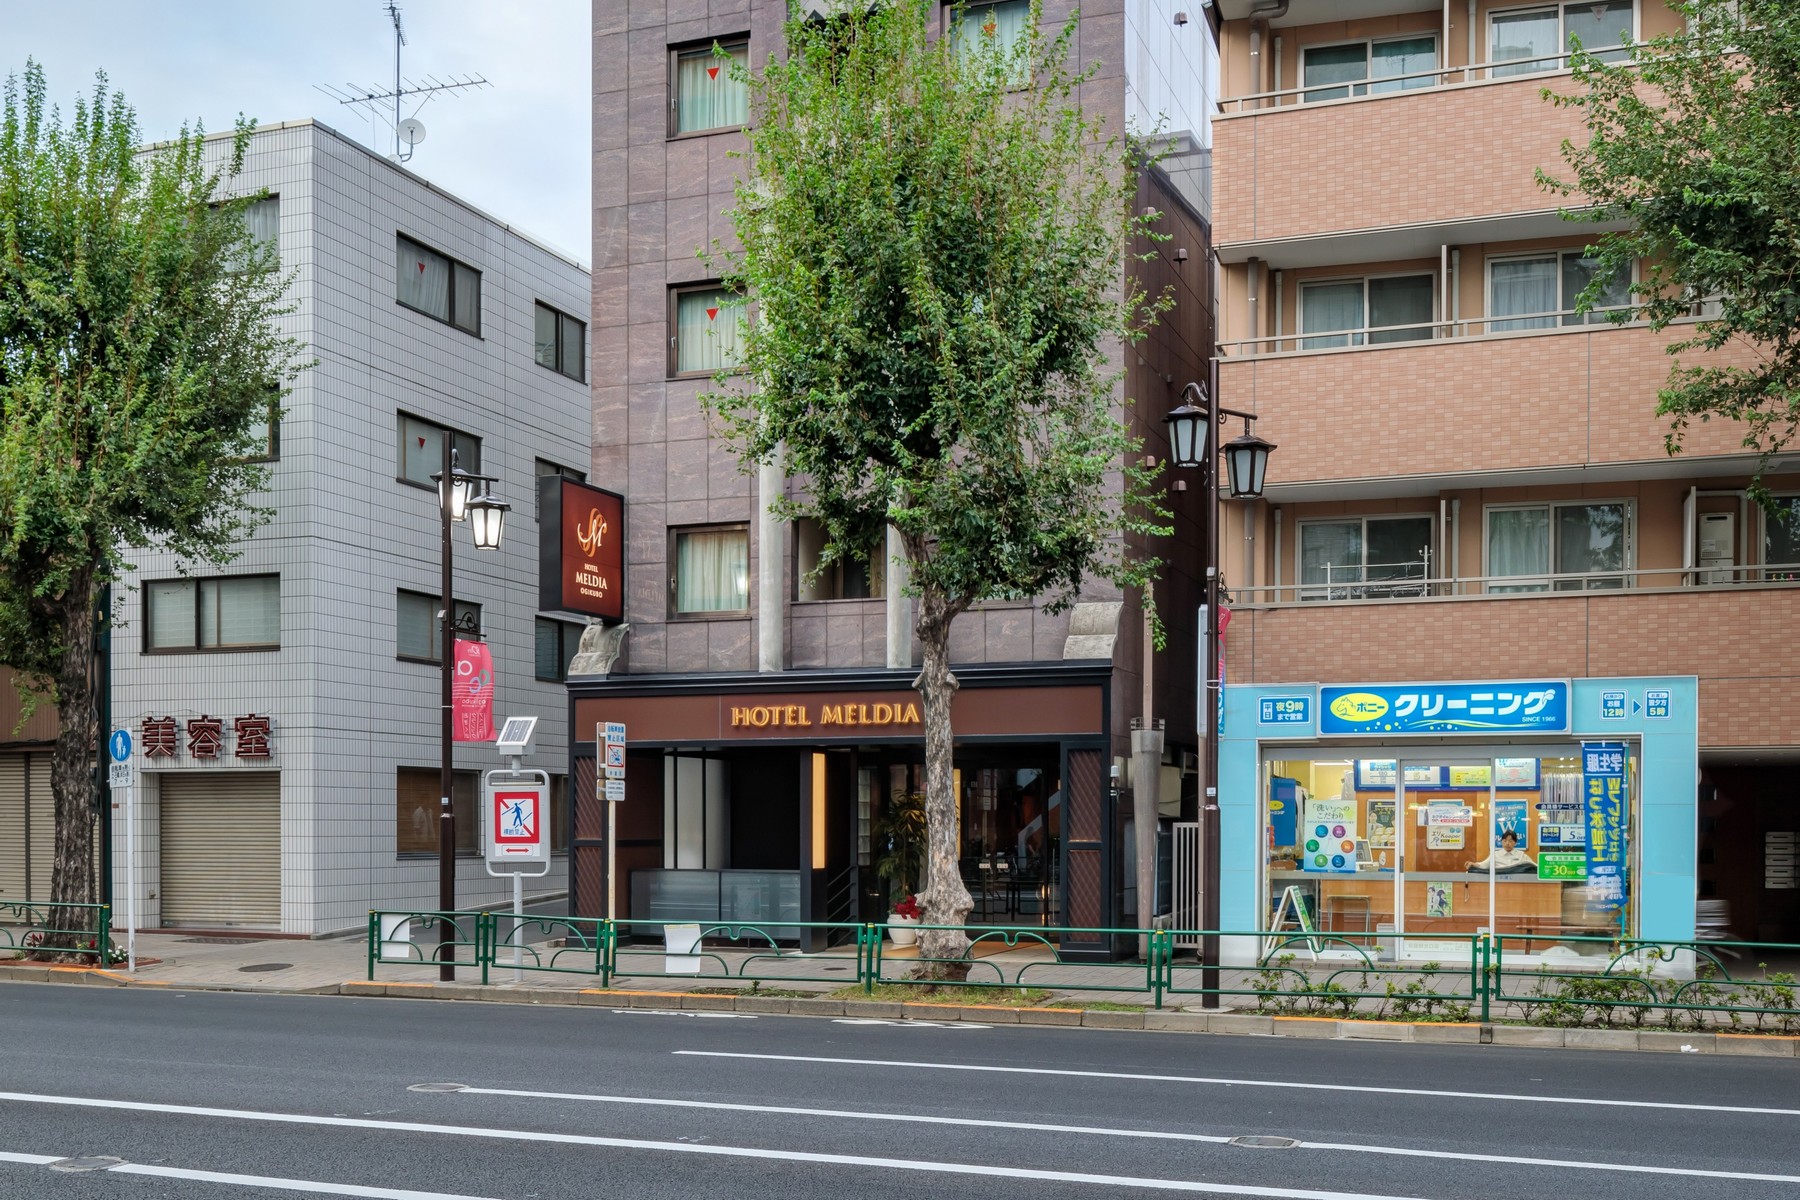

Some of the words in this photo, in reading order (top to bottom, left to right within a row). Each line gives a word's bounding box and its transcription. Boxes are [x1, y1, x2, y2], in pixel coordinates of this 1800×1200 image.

[584, 563, 599, 573] HOTEL
[575, 571, 608, 590] MELDIA
[580, 587, 603, 599] OGIKUBO
[1276, 700, 1304, 712] 夜9時
[1356, 702, 1385, 713] ポニー
[1395, 690, 1555, 717] クリーニング
[731, 705, 811, 726] HOTEL
[820, 703, 920, 725] MELDIA
[1277, 713, 1303, 721] まで営業
[1603, 708, 1624, 717] 12時
[1650, 707, 1666, 716] 5時
[142, 714, 271, 759] 美容室
[1317, 812, 1344, 820] こだわり
[503, 828, 526, 836] 横断禁止
[1569, 830, 1576, 840] 5
[1553, 864, 1568, 876] 30
